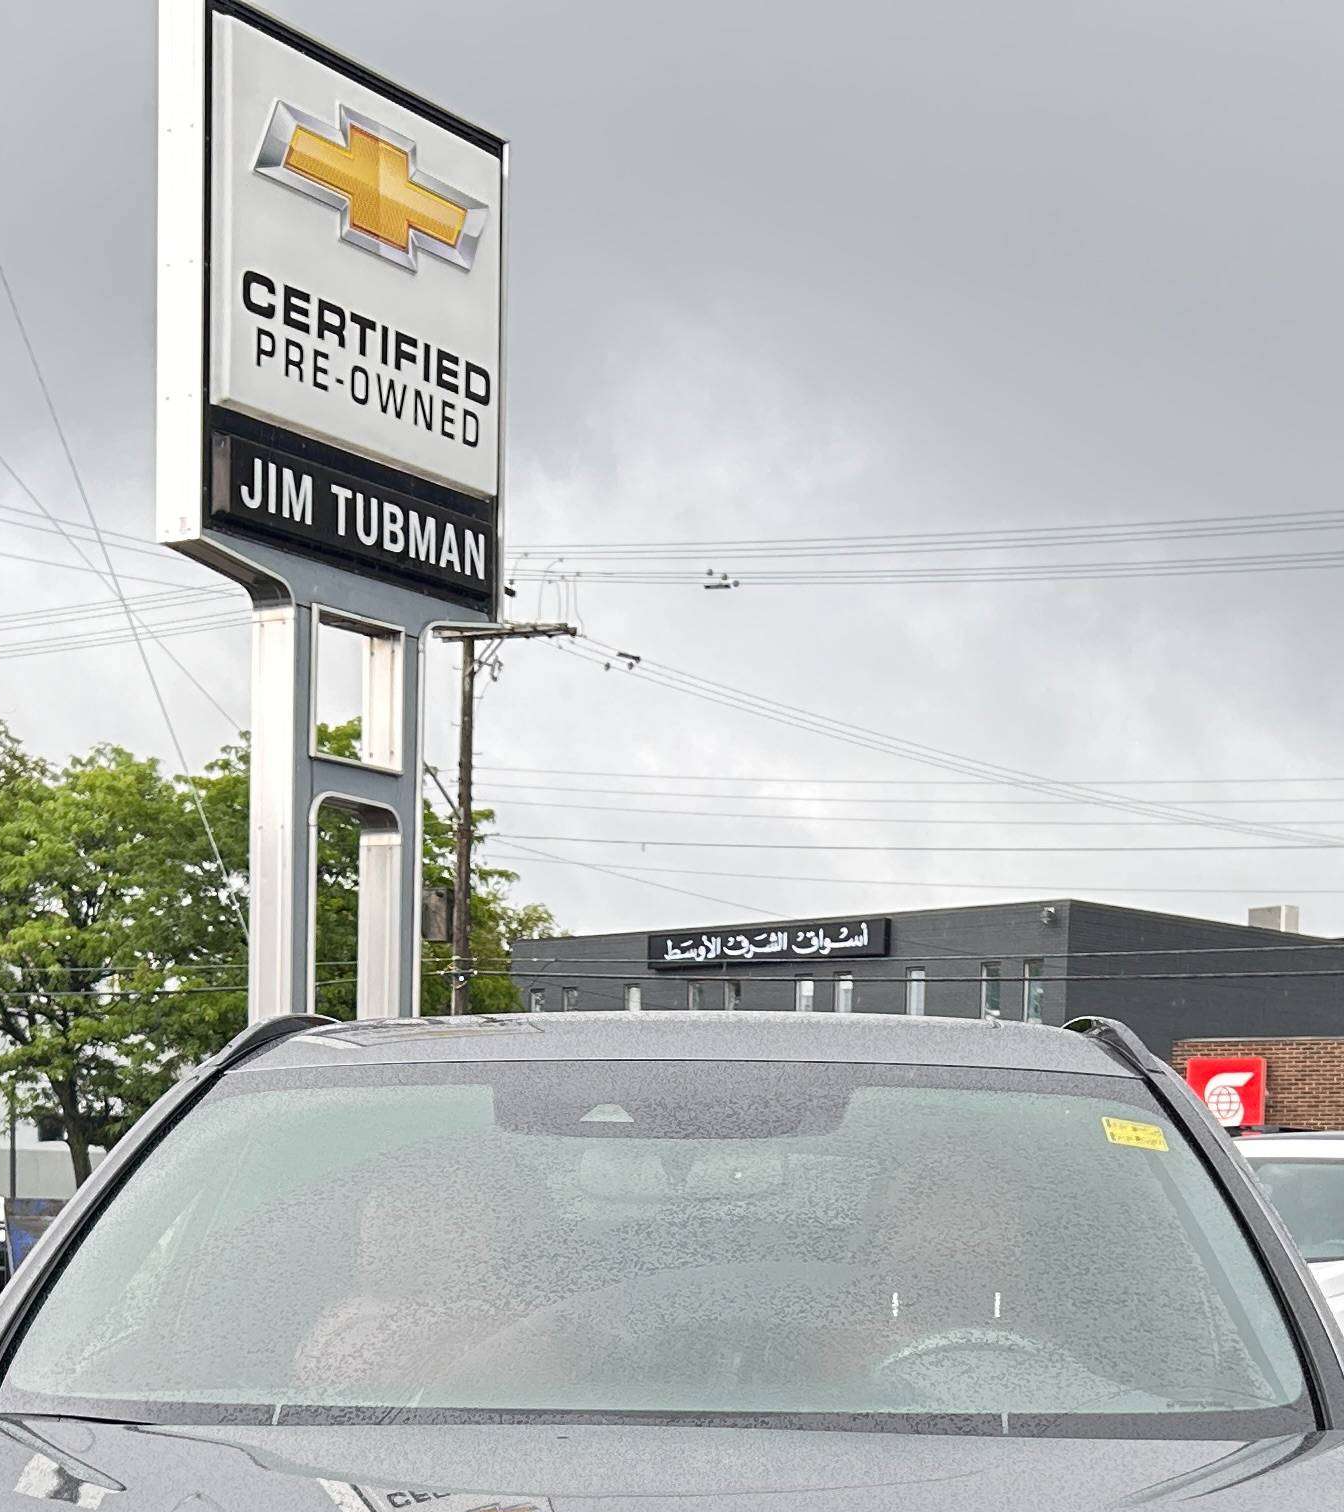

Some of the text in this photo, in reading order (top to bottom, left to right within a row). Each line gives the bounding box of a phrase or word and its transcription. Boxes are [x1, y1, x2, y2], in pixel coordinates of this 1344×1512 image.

[242, 270, 491, 407] CERTIFIED
[255, 326, 481, 449] PRE-OWNED
[240, 457, 486, 580] JIM TUBMAN
